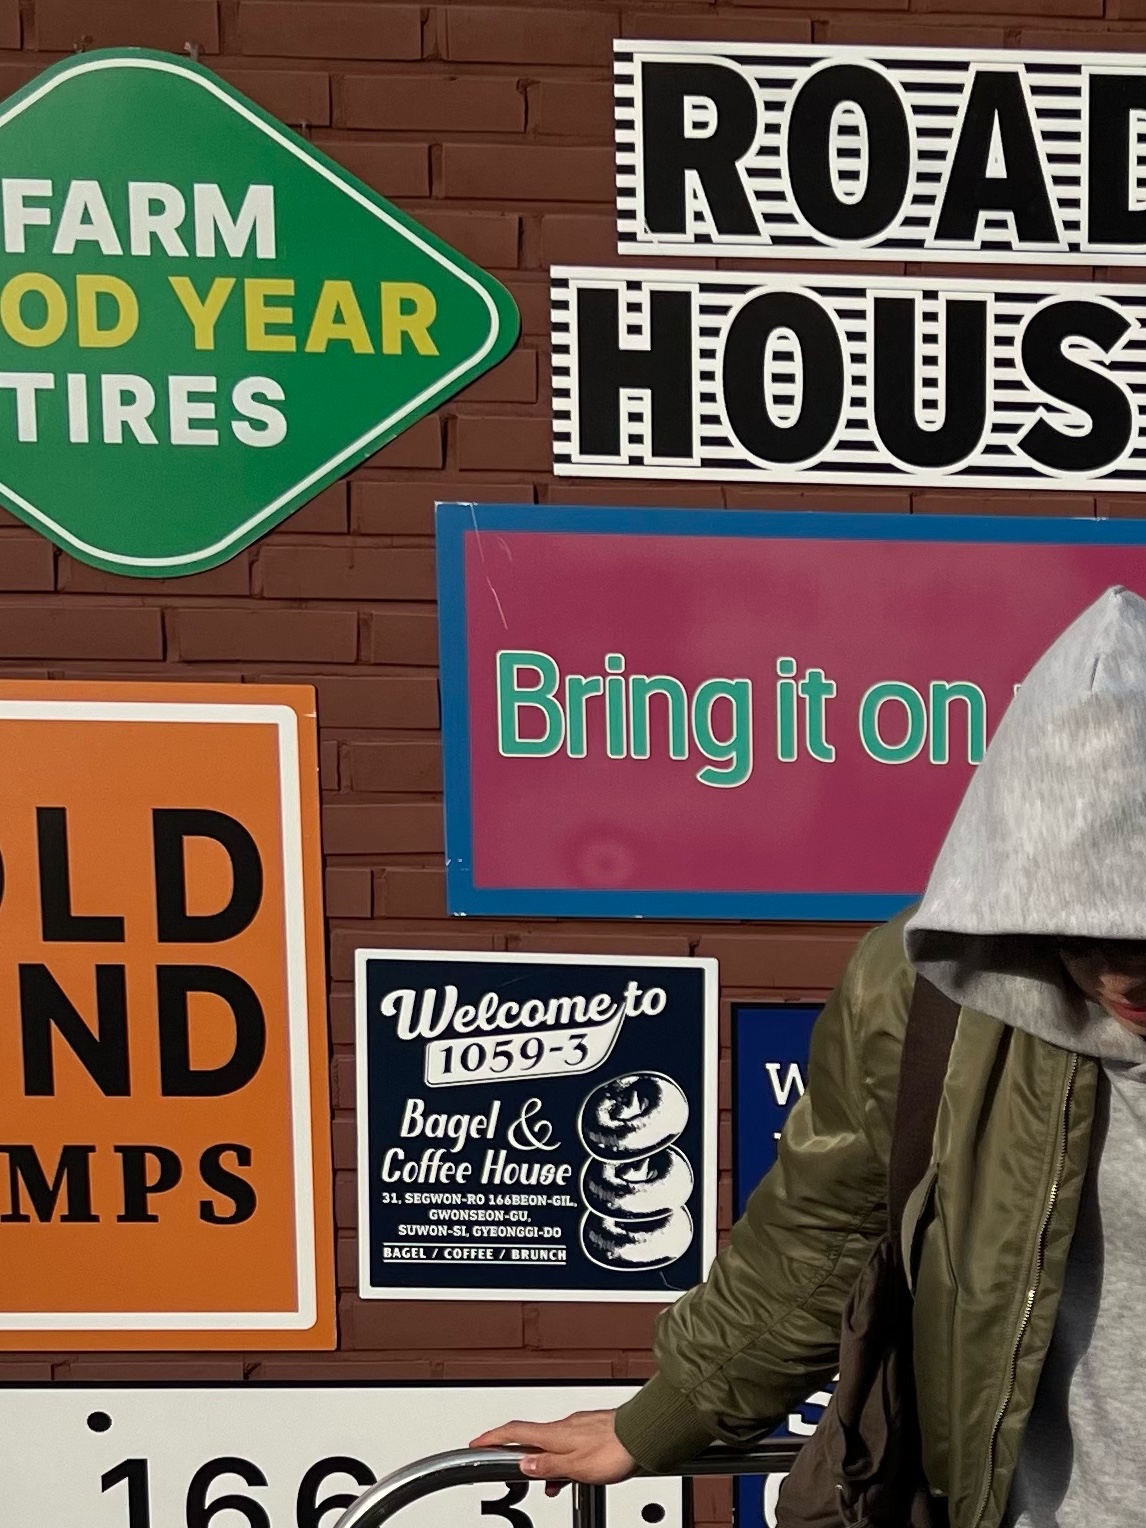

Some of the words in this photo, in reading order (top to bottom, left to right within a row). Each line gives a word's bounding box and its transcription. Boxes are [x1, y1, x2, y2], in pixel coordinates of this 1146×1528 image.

[2, 178, 276, 259] FARM
[0, 272, 139, 349] OD
[168, 277, 440, 356] YEAR
[0, 372, 288, 448] TIRES
[496, 649, 753, 788] Bring
[776, 656, 836, 763] it
[858, 680, 987, 765] on
[0, 806, 263, 943] LD
[18, 963, 267, 1097] ND
[380, 985, 618, 1041] Welcome
[623, 981, 667, 1016] to
[439, 1033, 590, 1075] 1059-3
[400, 1098, 501, 1153] Bagel
[507, 1097, 562, 1151] &
[0, 1144, 258, 1226] MPS
[381, 1147, 472, 1184] Coffee
[480, 1149, 572, 1186] House
[404, 1193, 485, 1205] SEGWON-RO
[429, 1209, 532, 1222] GWONSEON-GU,
[383, 1247, 427, 1259] BAGEL
[444, 1248, 494, 1260] COFFEE
[511, 1249, 567, 1261] BRUNCH
[472, 1226, 562, 1239] GYEONGGI-DO
